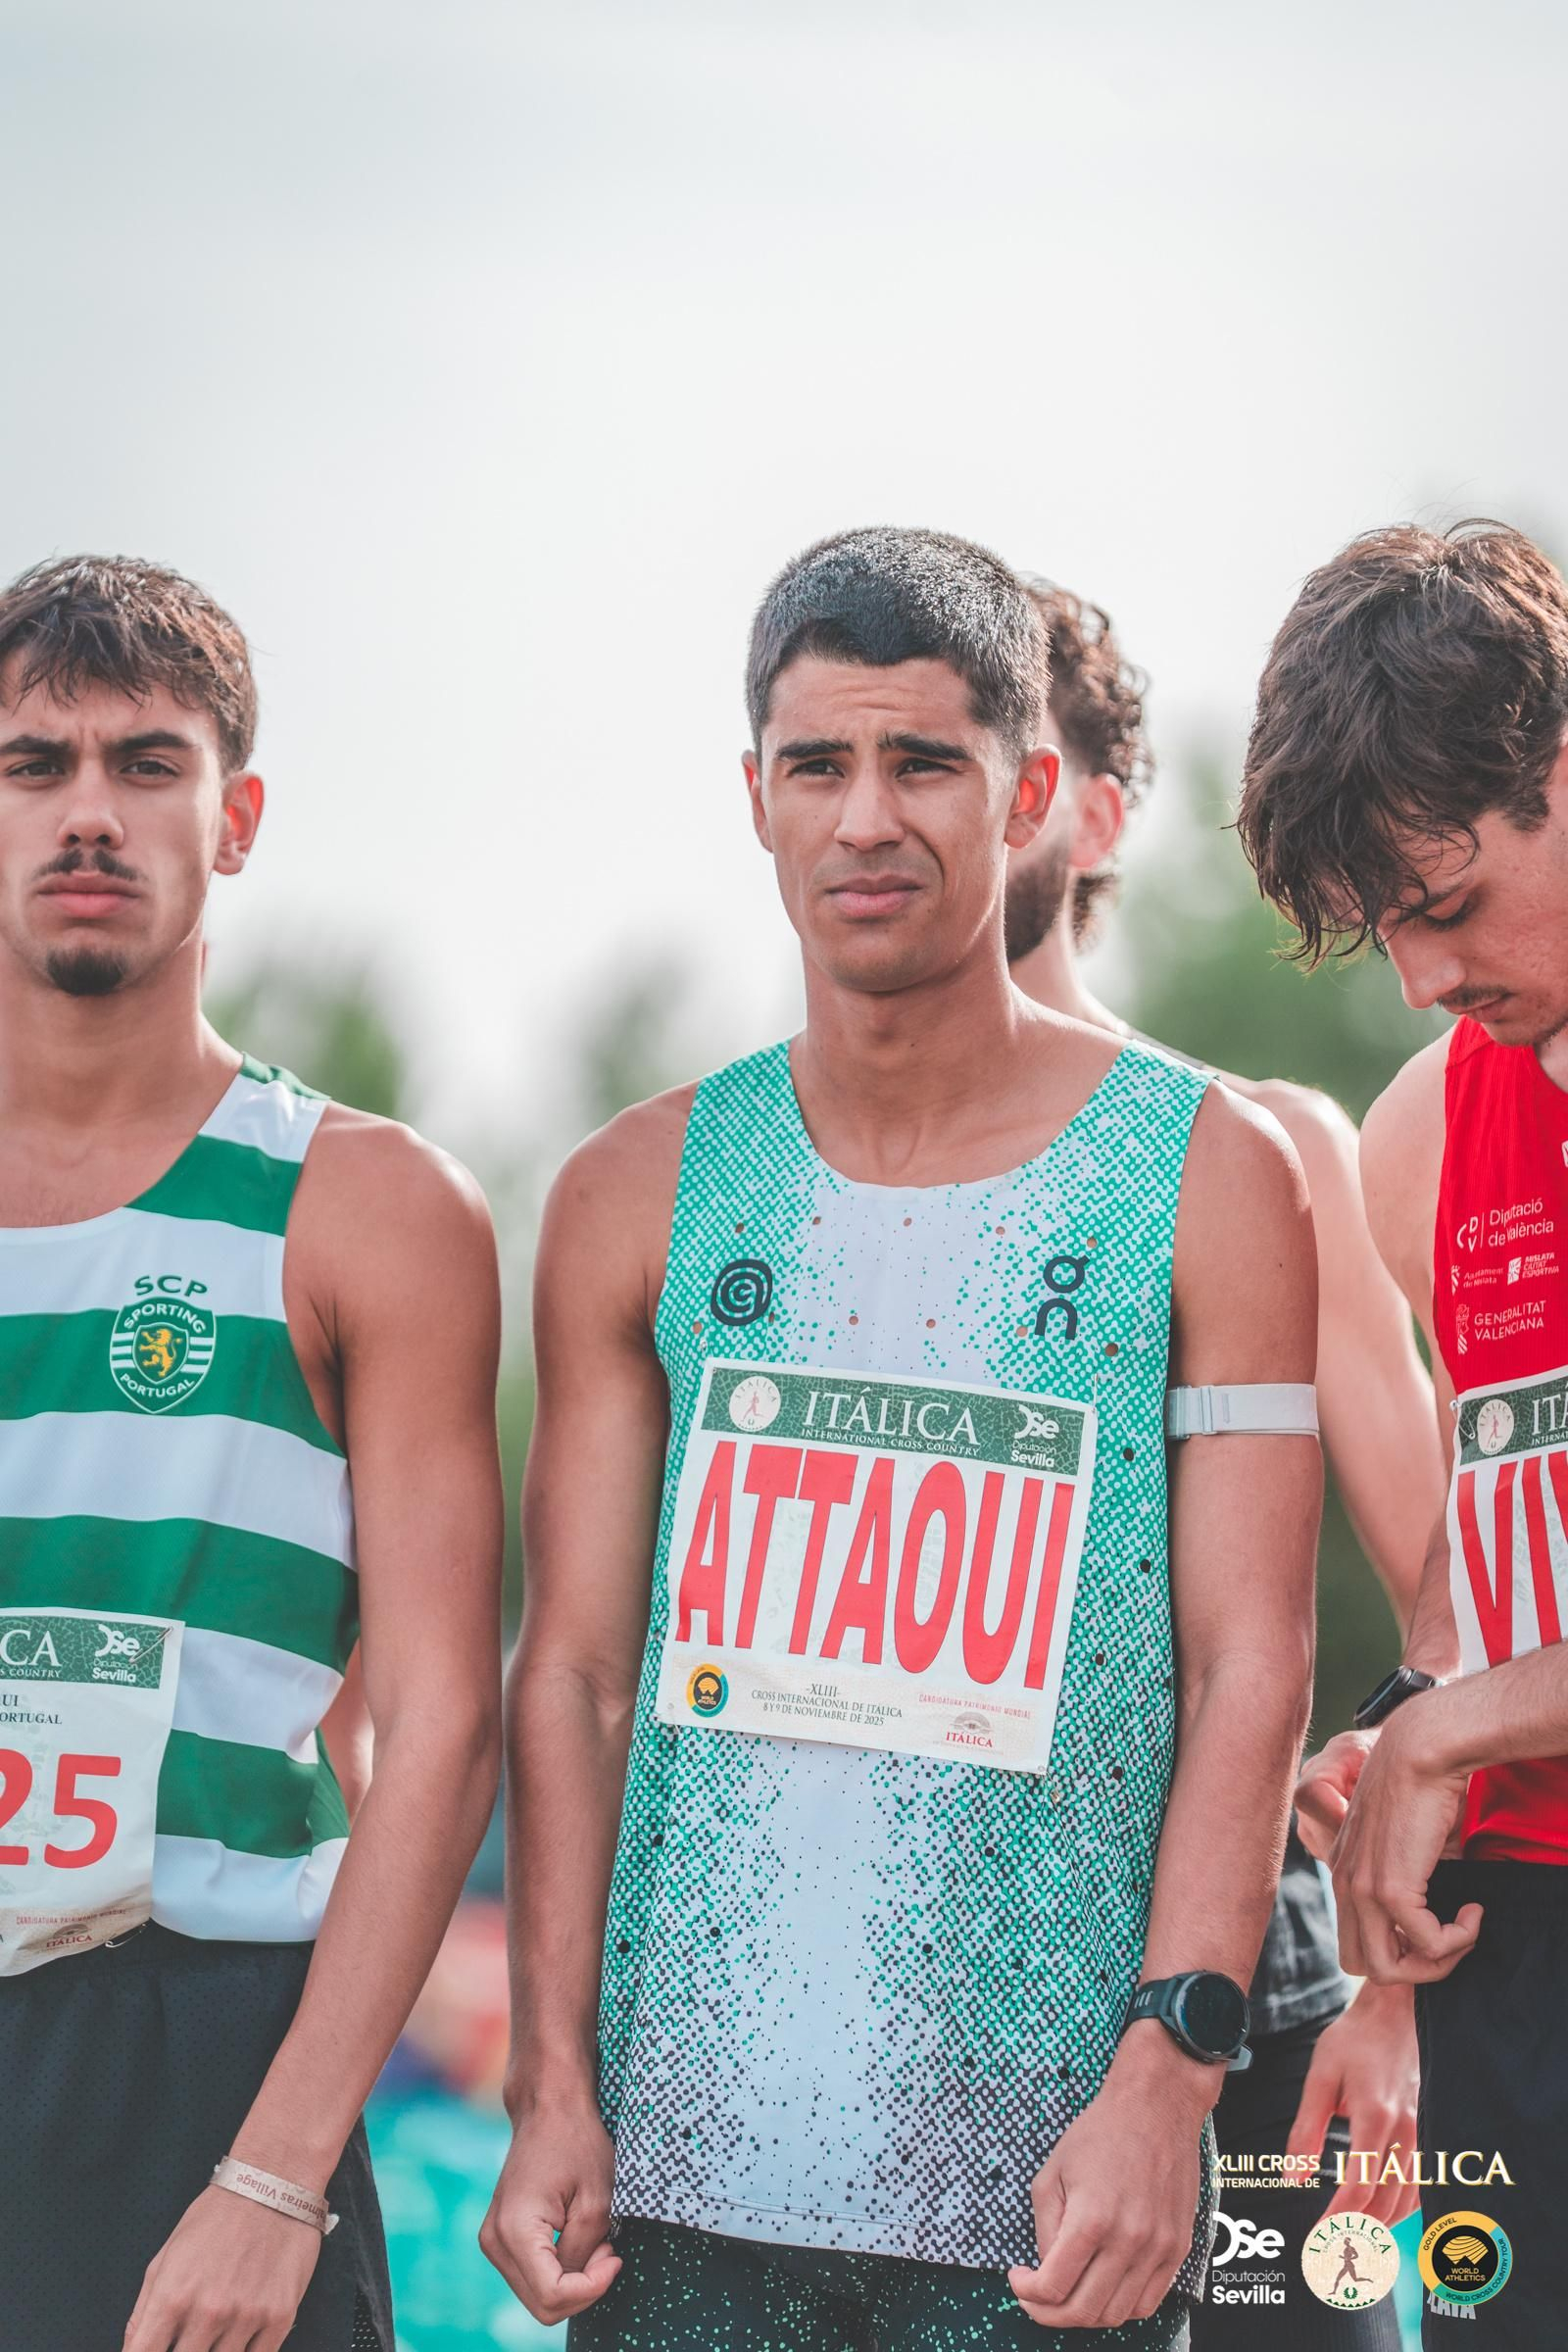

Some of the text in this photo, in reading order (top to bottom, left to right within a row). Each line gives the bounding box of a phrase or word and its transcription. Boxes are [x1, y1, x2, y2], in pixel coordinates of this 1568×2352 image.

[1490, 1198, 1543, 1227] Diputació
[1489, 1218, 1554, 1247] de València
[133, 1275, 208, 1298] SCP
[123, 1302, 207, 1334] SPORTING
[1474, 1299, 1546, 1326] GENERALITAT
[1474, 1317, 1544, 1341] VALENCIANA
[120, 1373, 196, 1398] PORTUGAL
[802, 1387, 981, 1446] ITÁLICA
[802, 1428, 980, 1457] INTERNATIONAL CROSS COUNTRY
[1010, 1449, 1055, 1468] Sevilla
[675, 1441, 1076, 1690] ATTAOUI
[9, 1668, 62, 1678] COUNTRY
[92, 1667, 136, 1683] Sevilla
[751, 1690, 776, 1701] CROSS
[777, 1692, 849, 1711] INTERNACIONAL
[852, 1701, 864, 1713] DE
[763, 1702, 768, 1712] 8
[769, 1703, 775, 1713] Y
[781, 1704, 792, 1715] DE
[794, 1706, 848, 1722] NOVIEMBRE
[850, 1712, 862, 1724] DE
[864, 1714, 885, 1726] 2025
[236, 2173, 277, 2199] Village
